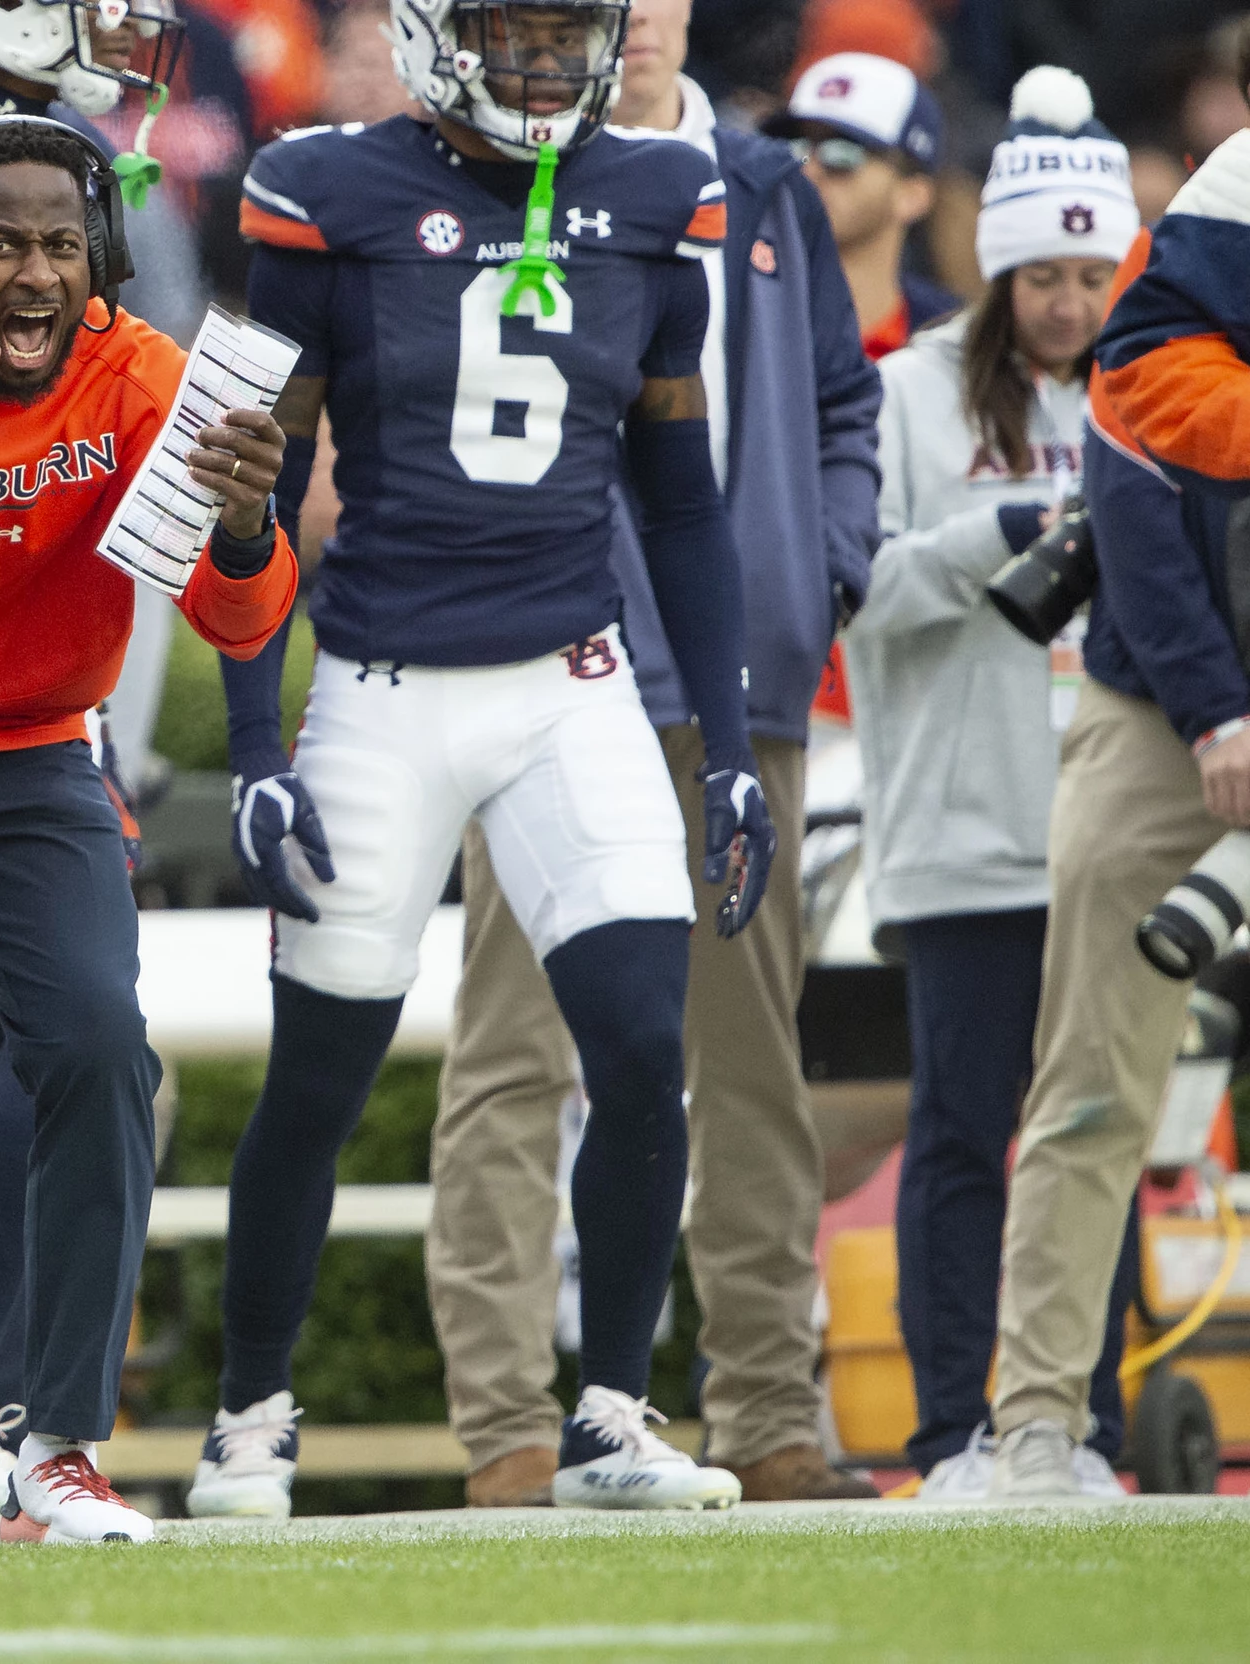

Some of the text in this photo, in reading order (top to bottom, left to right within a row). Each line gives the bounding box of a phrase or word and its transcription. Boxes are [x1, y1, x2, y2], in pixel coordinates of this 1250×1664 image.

[417, 210, 464, 256] SEC
[475, 240, 570, 261] AUBN
[449, 266, 573, 486] 6
